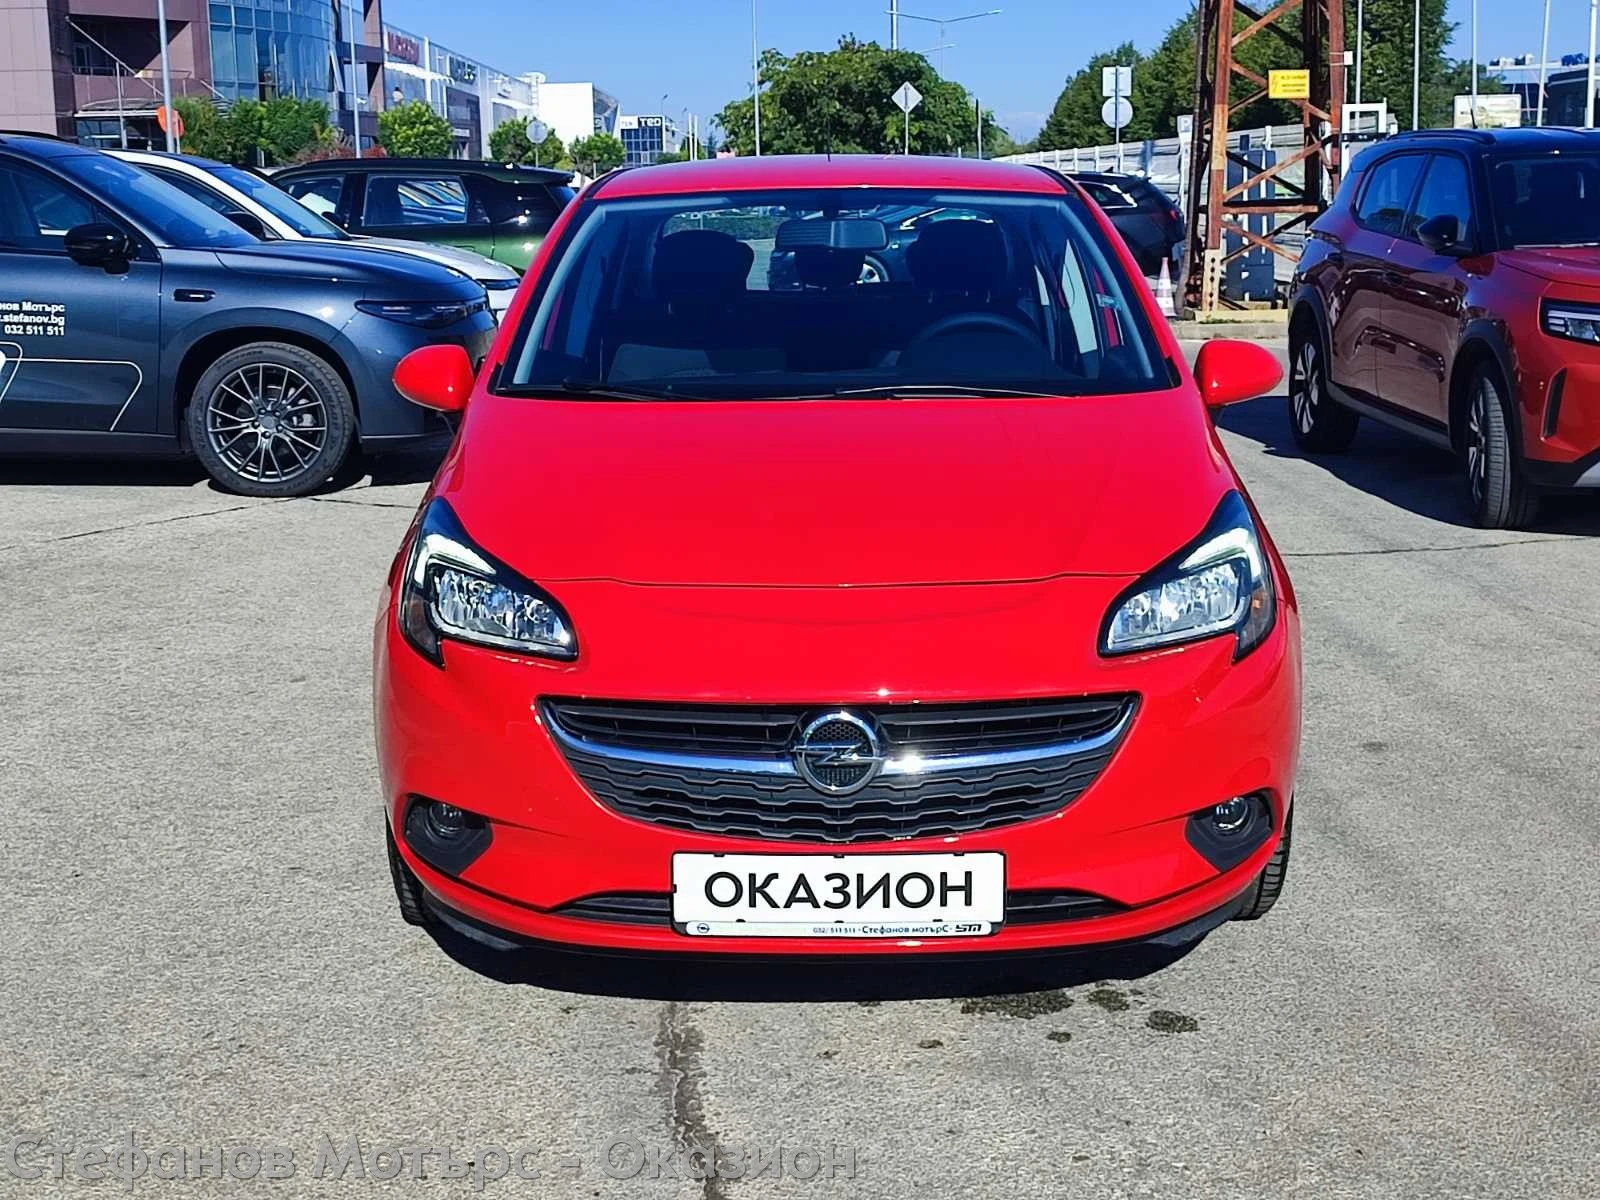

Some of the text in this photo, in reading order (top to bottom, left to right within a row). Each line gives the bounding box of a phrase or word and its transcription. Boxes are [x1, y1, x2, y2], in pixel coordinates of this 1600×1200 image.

[22, 301, 65, 313] Мотърс
[0, 314, 65, 326] .stefanov.bg
[4, 325, 65, 336] 032 511 511
[704, 871, 973, 909] ОКАЗИОН
